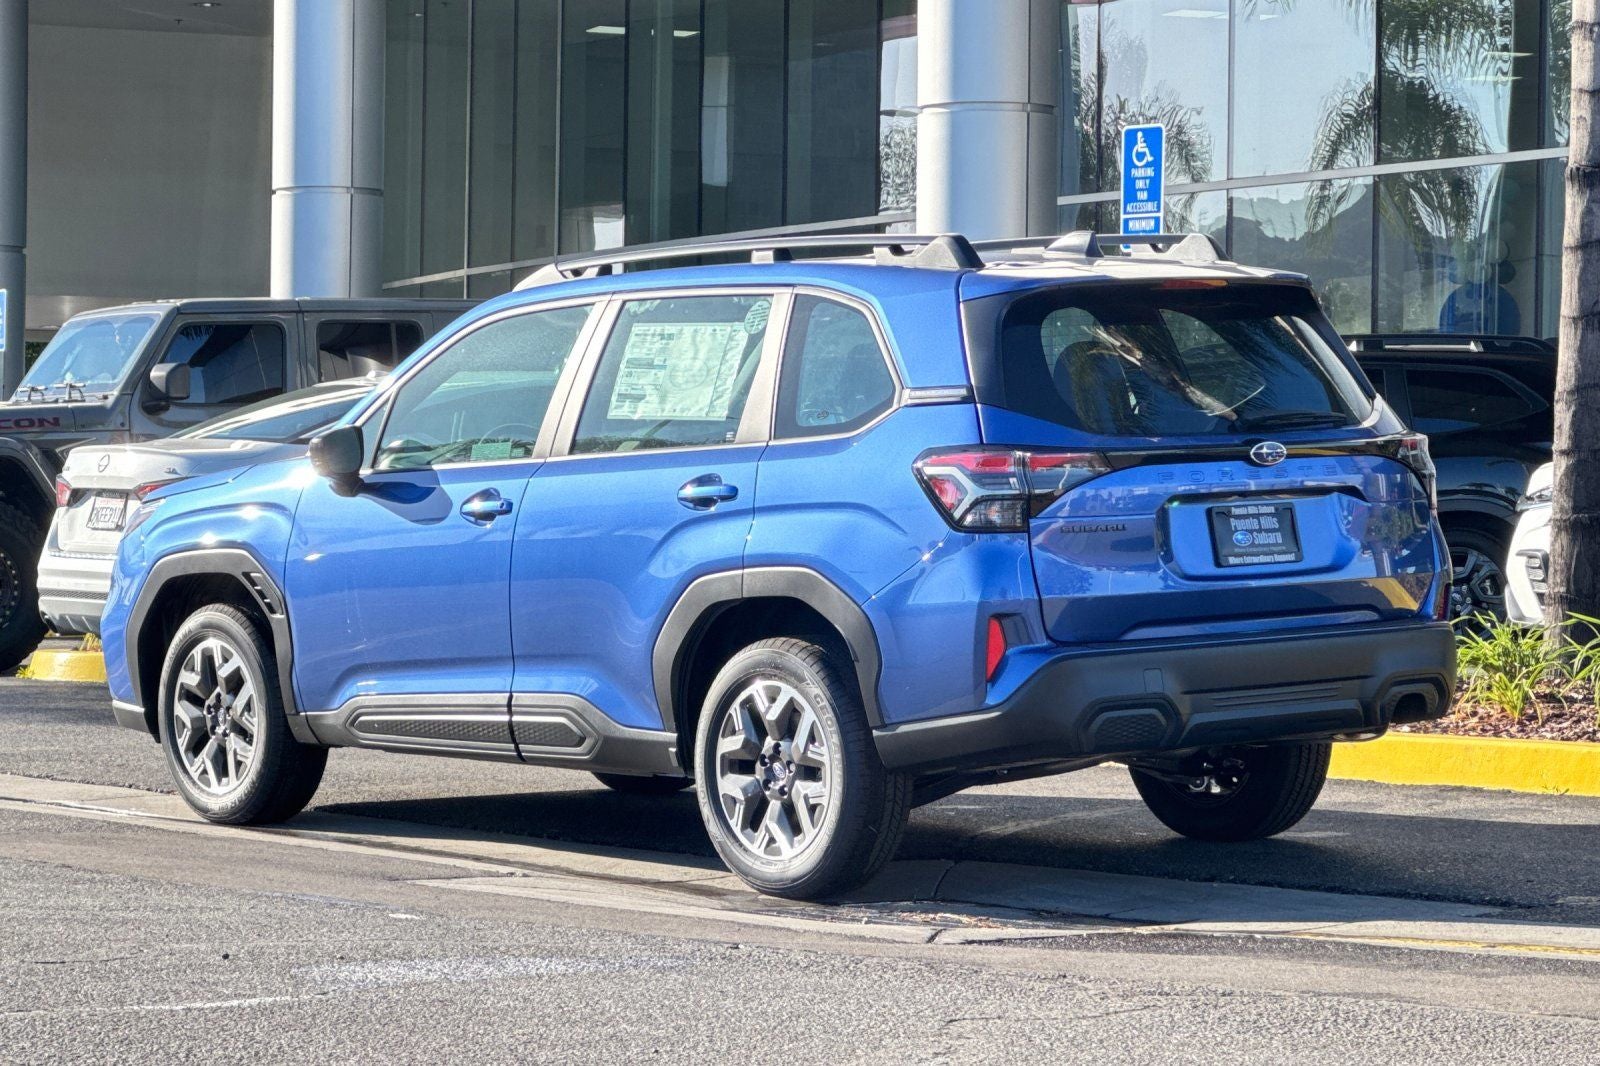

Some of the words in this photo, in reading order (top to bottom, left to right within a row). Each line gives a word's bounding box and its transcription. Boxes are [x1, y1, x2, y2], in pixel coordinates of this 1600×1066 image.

[1131, 168, 1154, 177] PARKING
[1135, 179, 1150, 189] ONLY
[1137, 191, 1148, 200] VAN
[1127, 202, 1157, 212] ACCESSIBLE
[1129, 219, 1154, 230] MINIMUM
[1231, 518, 1259, 530] Puente
[1260, 516, 1278, 528] Hills
[1253, 532, 1282, 544] Subaru
